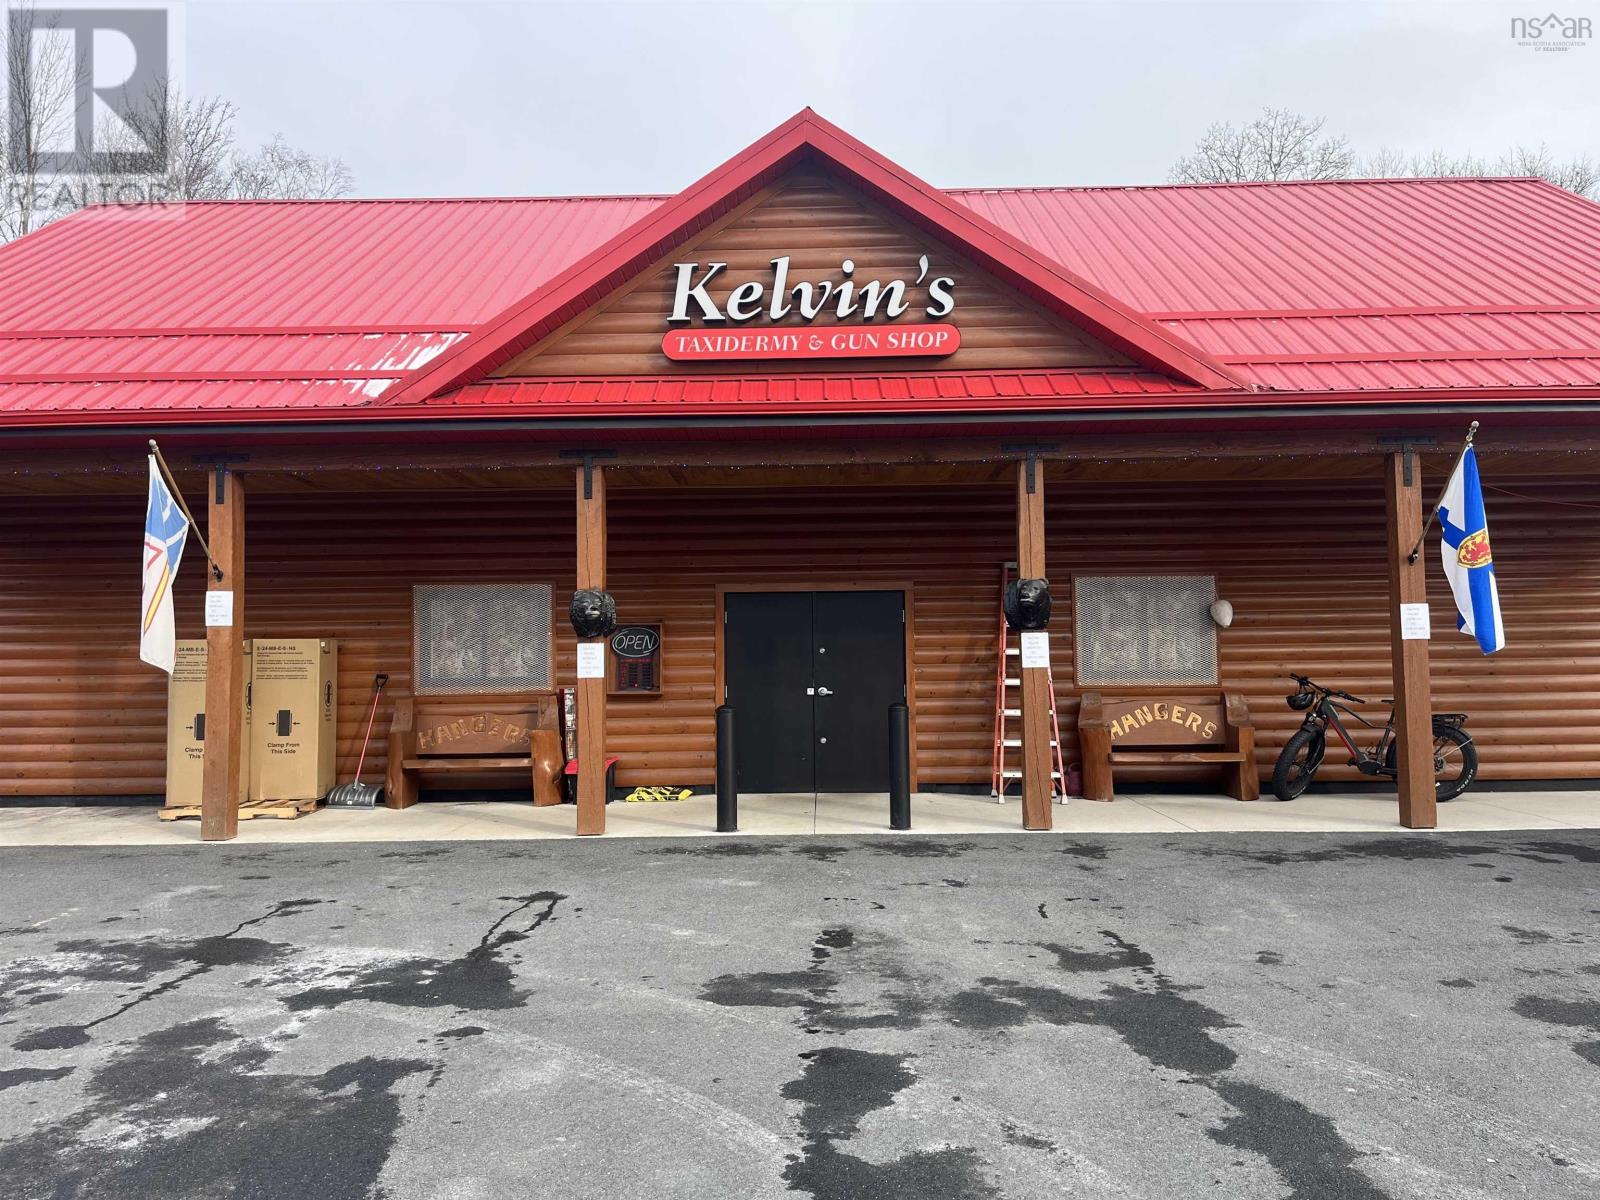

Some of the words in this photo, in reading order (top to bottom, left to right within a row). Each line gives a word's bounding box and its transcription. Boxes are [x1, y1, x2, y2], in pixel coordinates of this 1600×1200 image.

[666, 255, 957, 323] Kelvin's
[675, 335, 803, 353] TAXIDERMY
[808, 334, 825, 351] &
[831, 331, 880, 350] GUN
[887, 330, 950, 349] SHOP
[615, 634, 655, 650] OPEN
[417, 715, 530, 749] HANGERS
[1111, 702, 1218, 740] HANGERS
